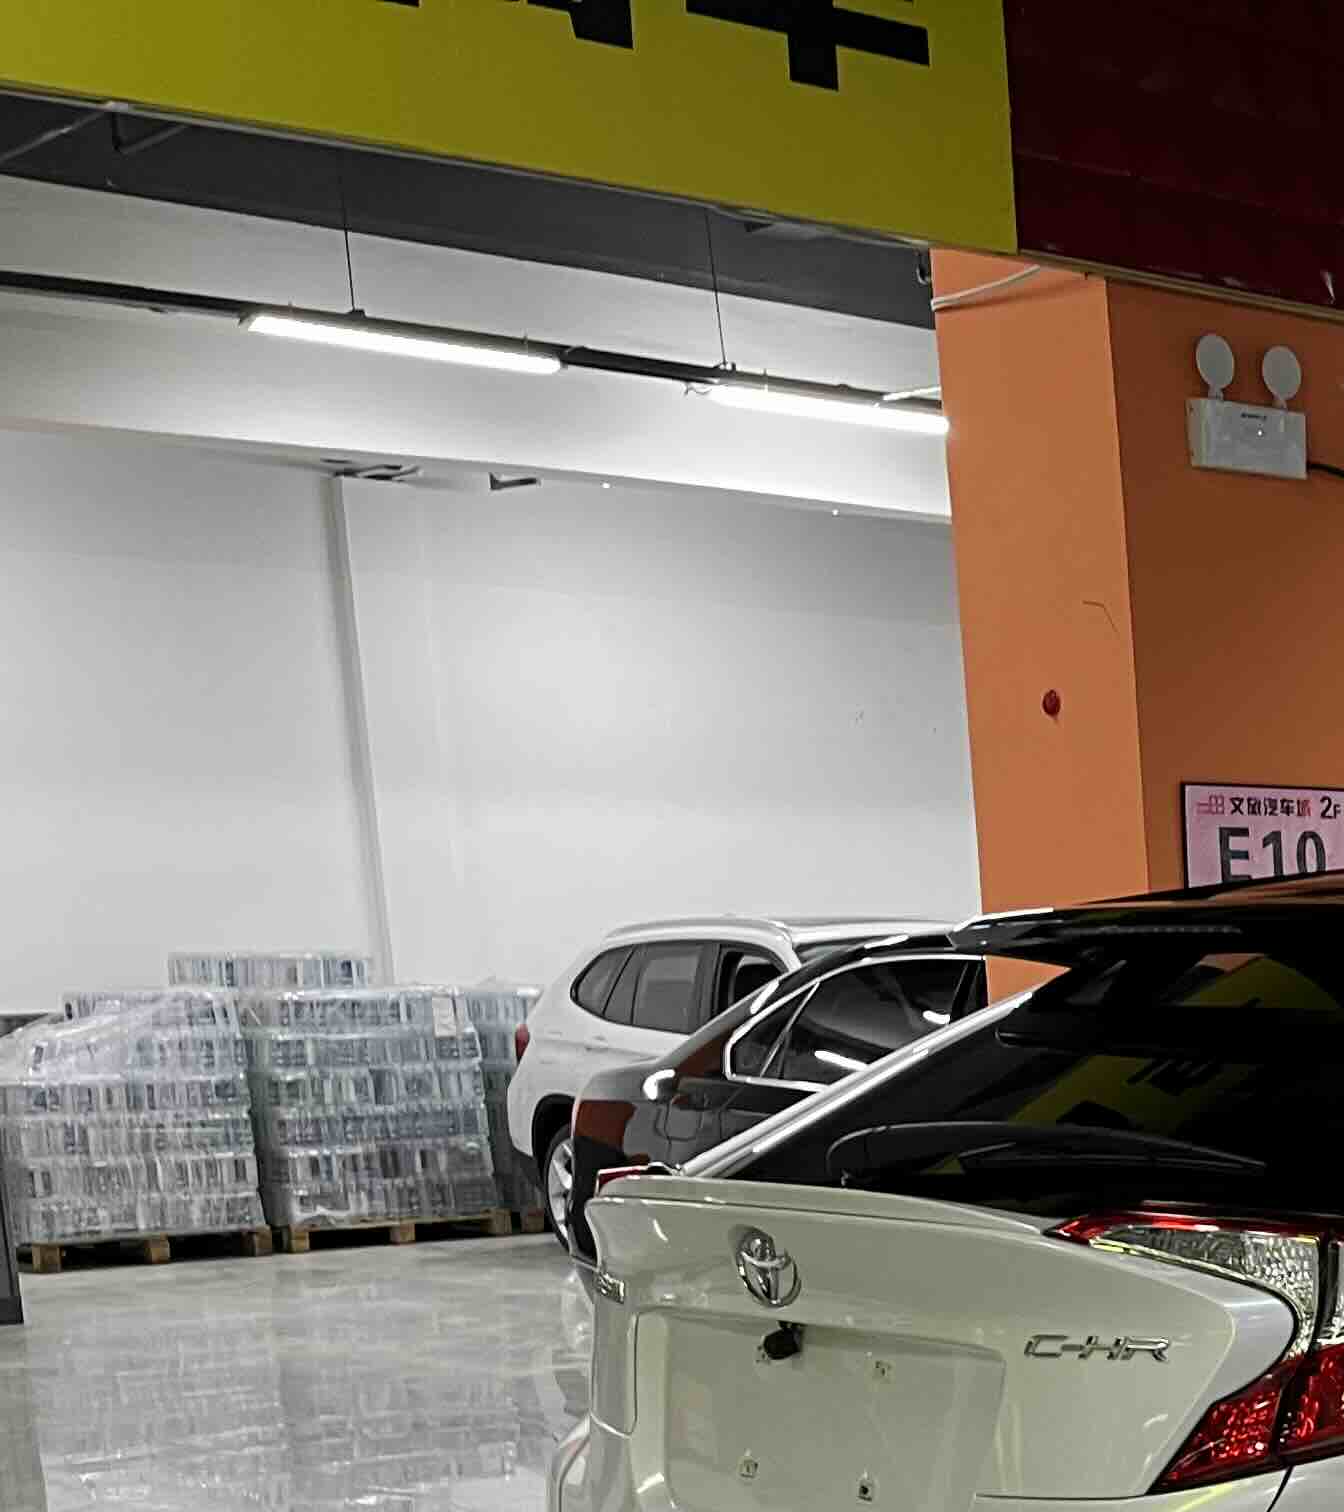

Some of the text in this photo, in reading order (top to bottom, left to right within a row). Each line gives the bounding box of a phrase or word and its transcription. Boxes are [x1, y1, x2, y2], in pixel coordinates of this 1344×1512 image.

[1320, 796, 1341, 819] 2F
[1218, 827, 1327, 882] E10
[1023, 1334, 1170, 1362] C-HR
